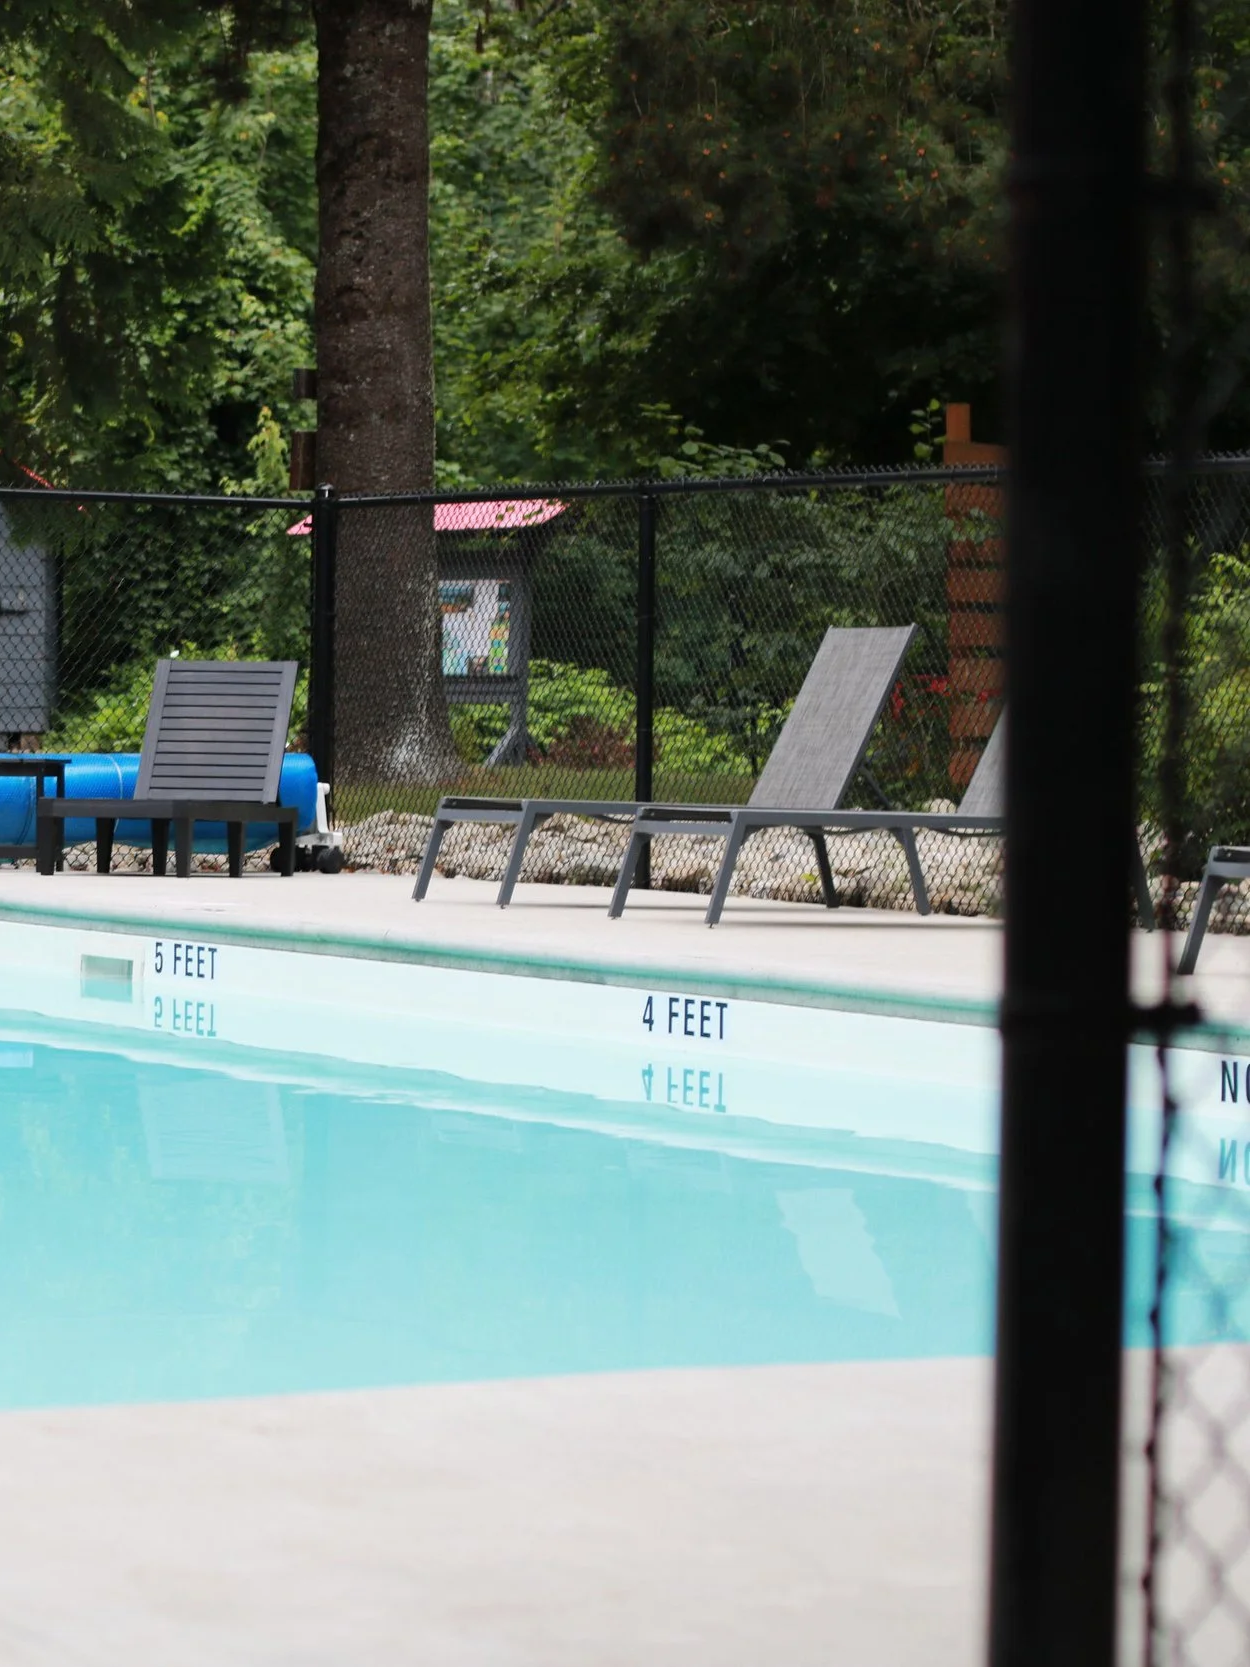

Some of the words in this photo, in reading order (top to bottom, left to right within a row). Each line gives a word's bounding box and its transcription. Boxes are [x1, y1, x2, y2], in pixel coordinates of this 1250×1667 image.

[154, 941, 163, 974] 5
[173, 943, 217, 980] FEET
[642, 995, 655, 1032] 4
[668, 996, 728, 1040] FEET
